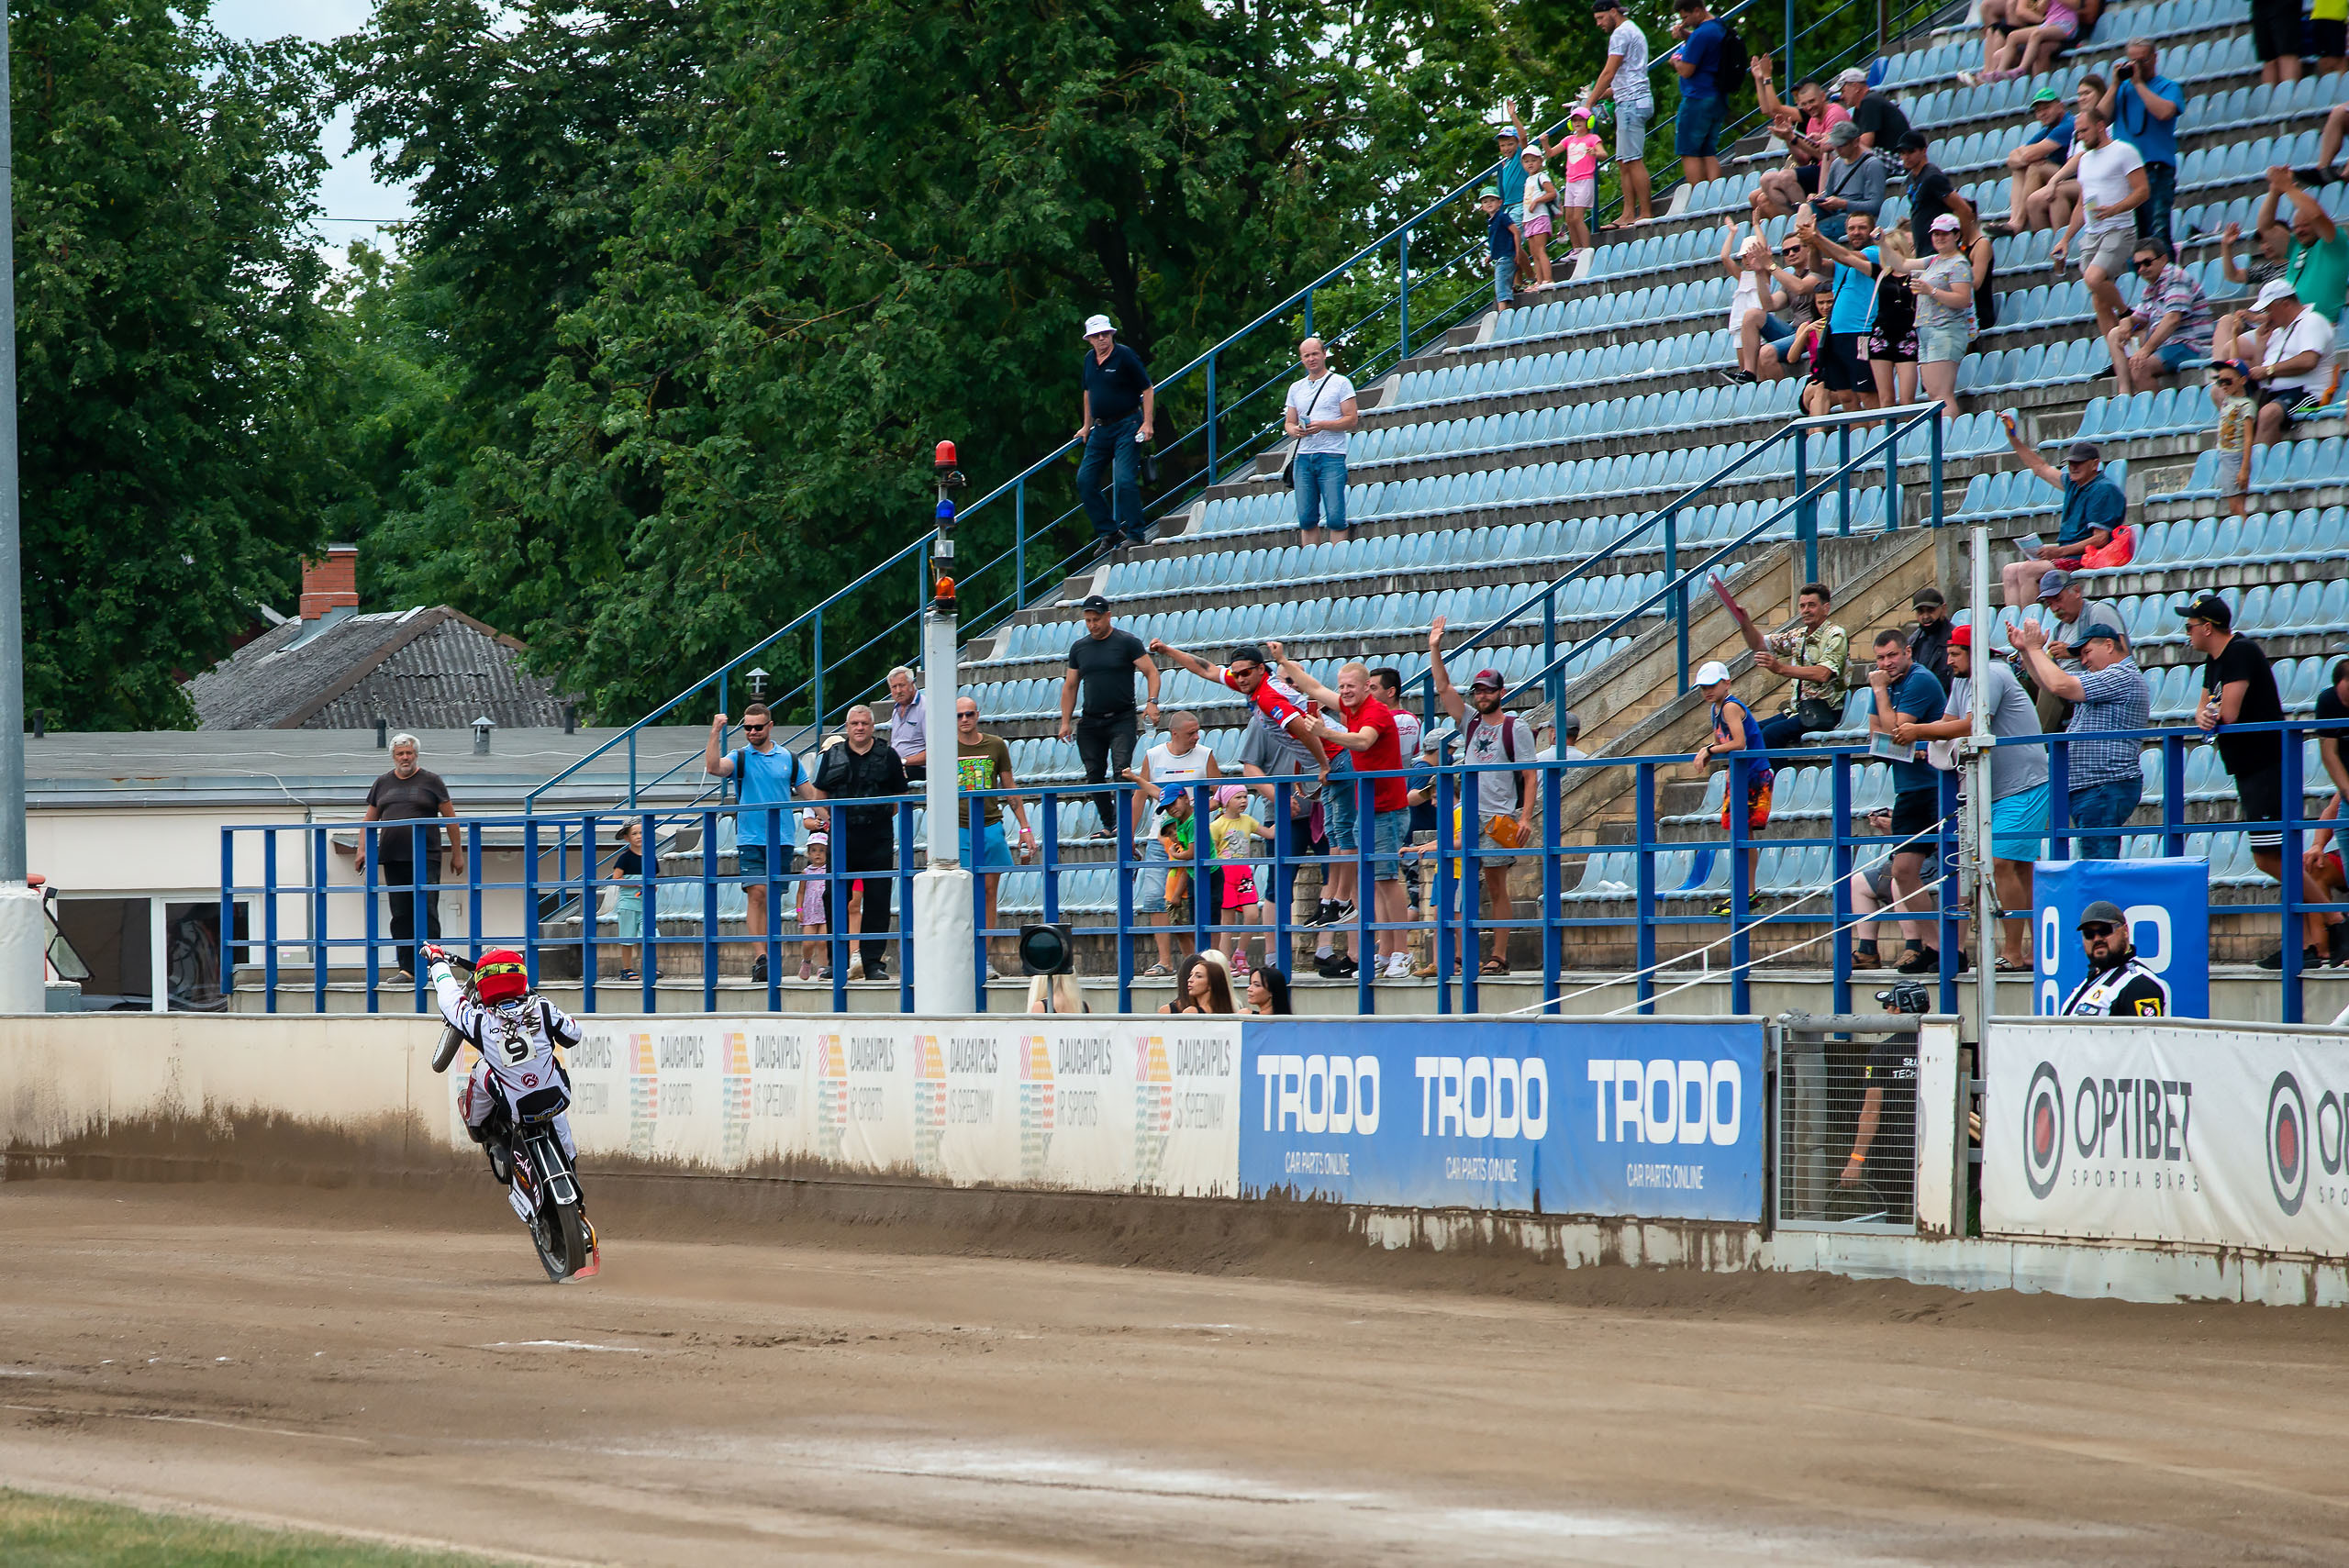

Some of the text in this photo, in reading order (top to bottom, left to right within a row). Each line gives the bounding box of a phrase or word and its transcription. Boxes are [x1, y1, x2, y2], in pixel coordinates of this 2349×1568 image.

[504, 1036, 529, 1064] 9
[660, 1036, 705, 1069] DAUGAVPILS
[755, 1035, 801, 1070] DAUGAVPILS
[851, 1037, 895, 1073] DAUGAVPILS
[950, 1038, 998, 1074] DAUGAVPILS
[1058, 1039, 1112, 1075] DAUGAVPILS
[1176, 1039, 1230, 1077] DAUGAVPILS
[1067, 1090, 1098, 1128] SPORTS
[1257, 1054, 1380, 1135] TRODO
[1415, 1056, 1549, 1140] TRODO
[1587, 1059, 1742, 1146] TRODO
[2075, 1076, 2192, 1162] OPTIBET
[1285, 1151, 1351, 1176] CAR PARTS ONLINE
[1445, 1156, 1518, 1183] CAR PARTS ONLINE
[1627, 1162, 1704, 1190] CAR PARTS ONLINE
[2071, 1168, 2143, 1189] SPORTA
